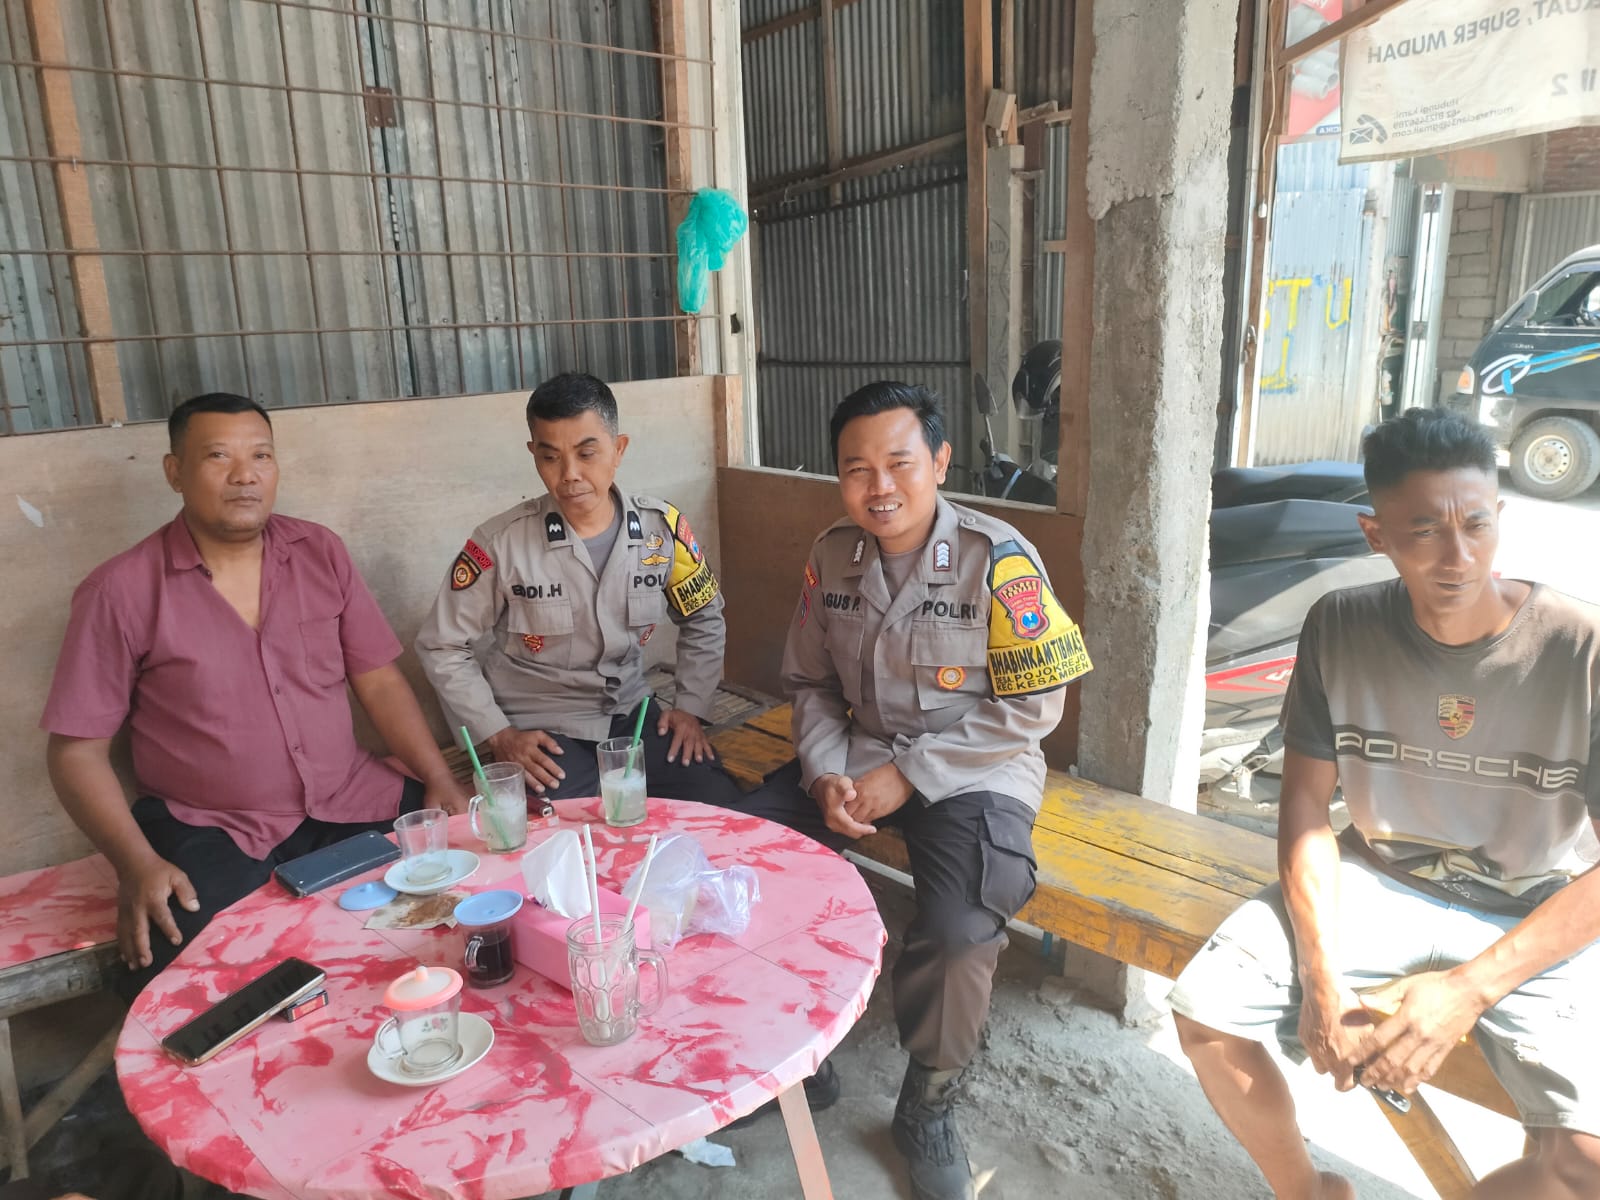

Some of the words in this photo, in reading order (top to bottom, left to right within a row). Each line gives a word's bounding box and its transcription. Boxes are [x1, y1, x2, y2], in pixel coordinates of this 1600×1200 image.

[921, 600, 978, 620] POLRI
[1014, 653, 1087, 682] POJOKREJO
[1016, 662, 1090, 691] KESAMBEN
[1335, 731, 1580, 789] PORSCHE
